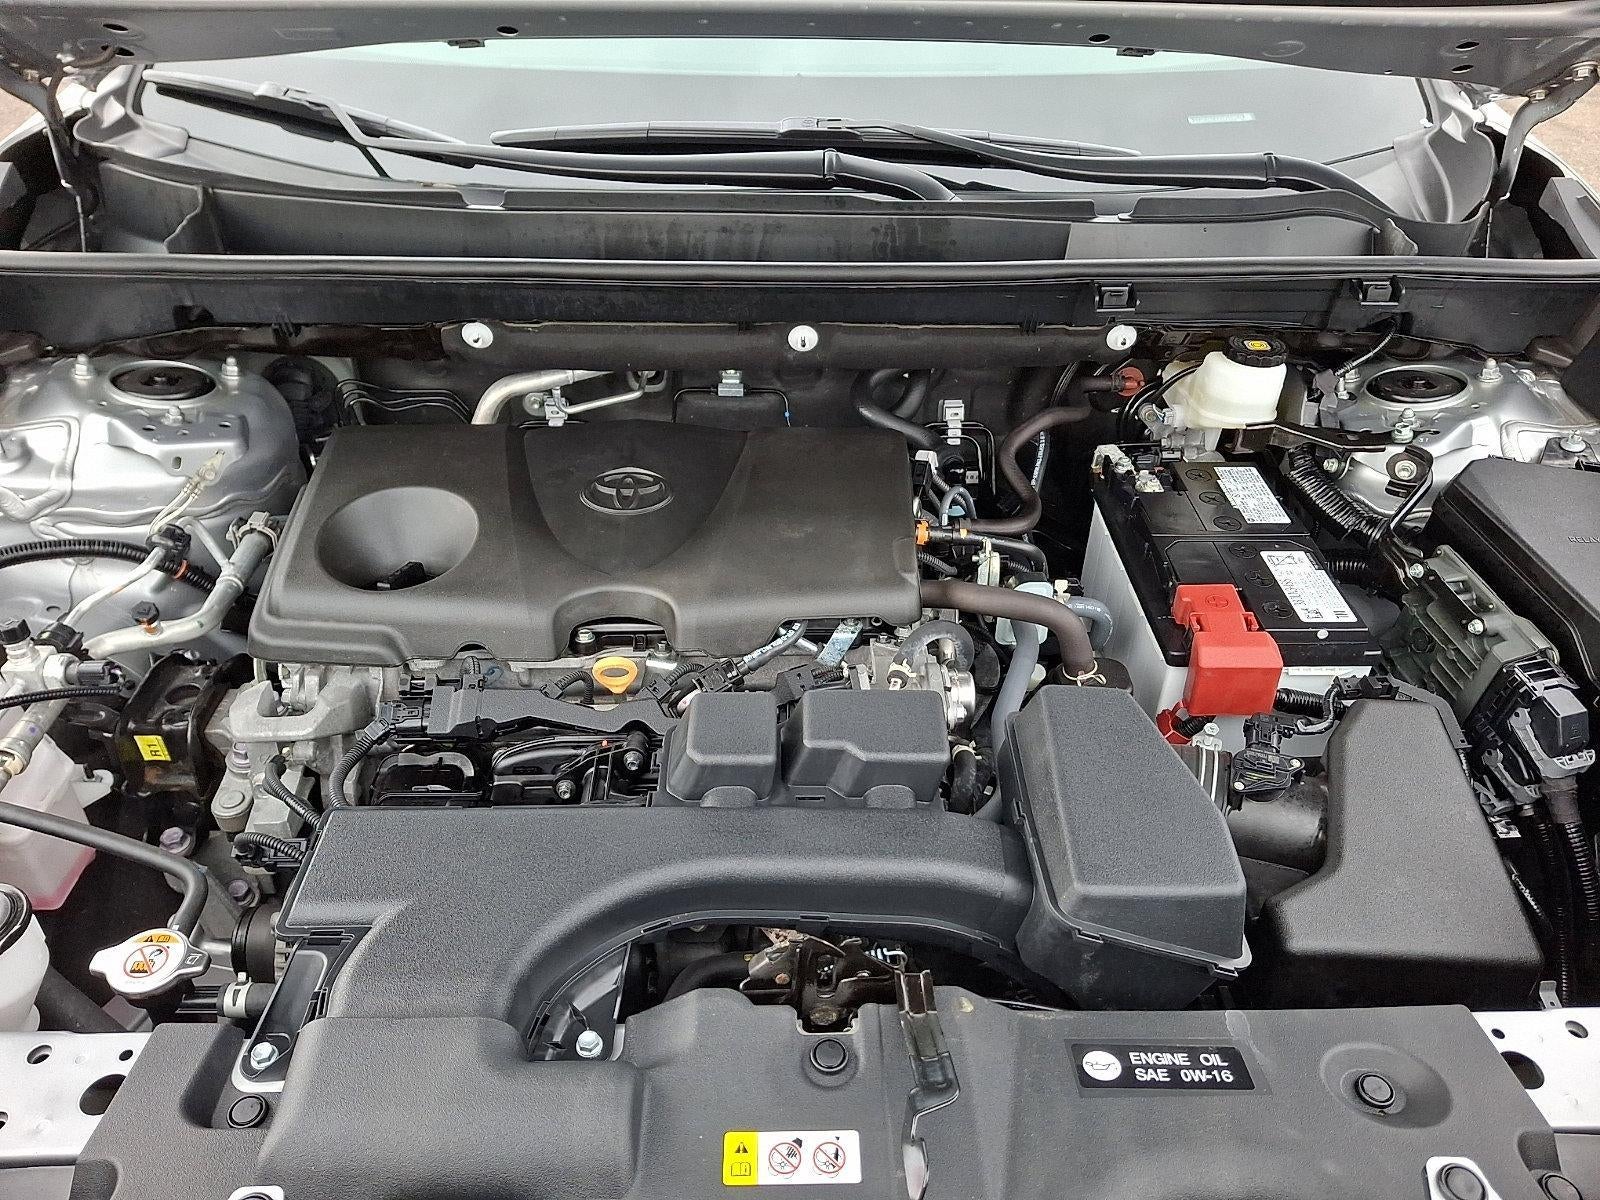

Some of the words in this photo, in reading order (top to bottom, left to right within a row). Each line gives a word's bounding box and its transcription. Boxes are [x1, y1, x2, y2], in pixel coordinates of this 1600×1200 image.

[1128, 1052, 1191, 1066] ENGINE
[1199, 1053, 1229, 1067] OIL
[1135, 1068, 1171, 1082] SAE
[1180, 1069, 1234, 1083] 0W-16
